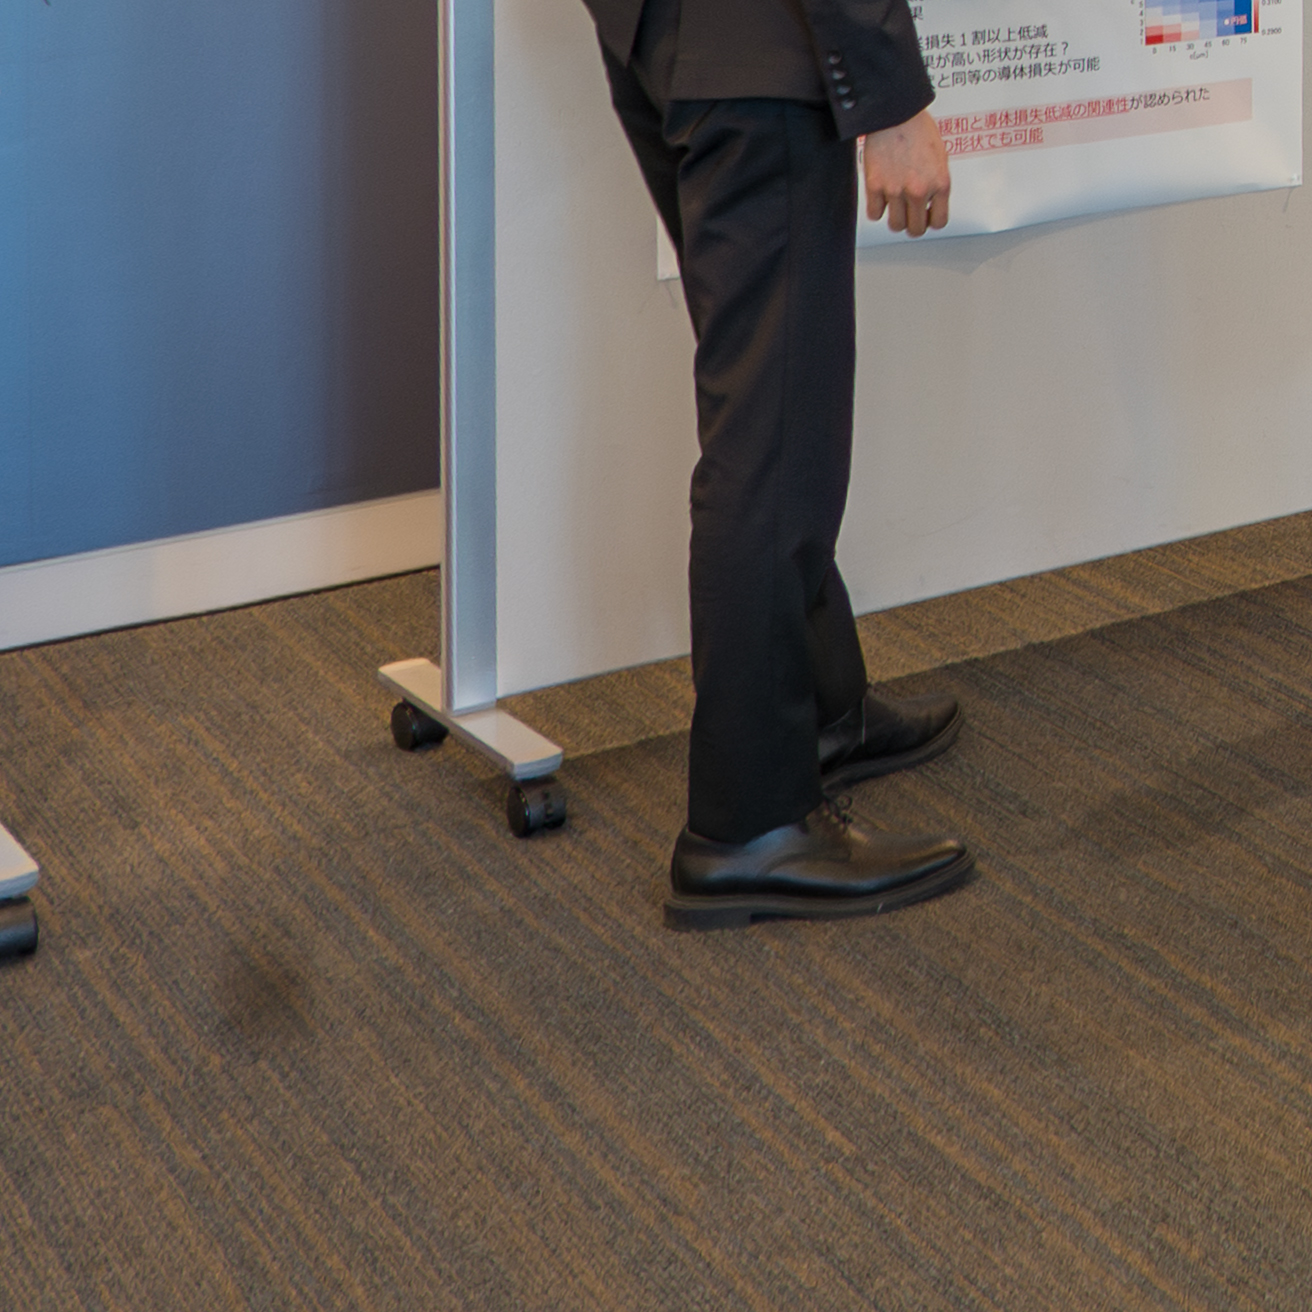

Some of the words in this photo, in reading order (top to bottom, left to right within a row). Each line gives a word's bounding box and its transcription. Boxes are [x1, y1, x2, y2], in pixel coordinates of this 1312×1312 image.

[931, 56, 1100, 89] と同等の導体損失が可能
